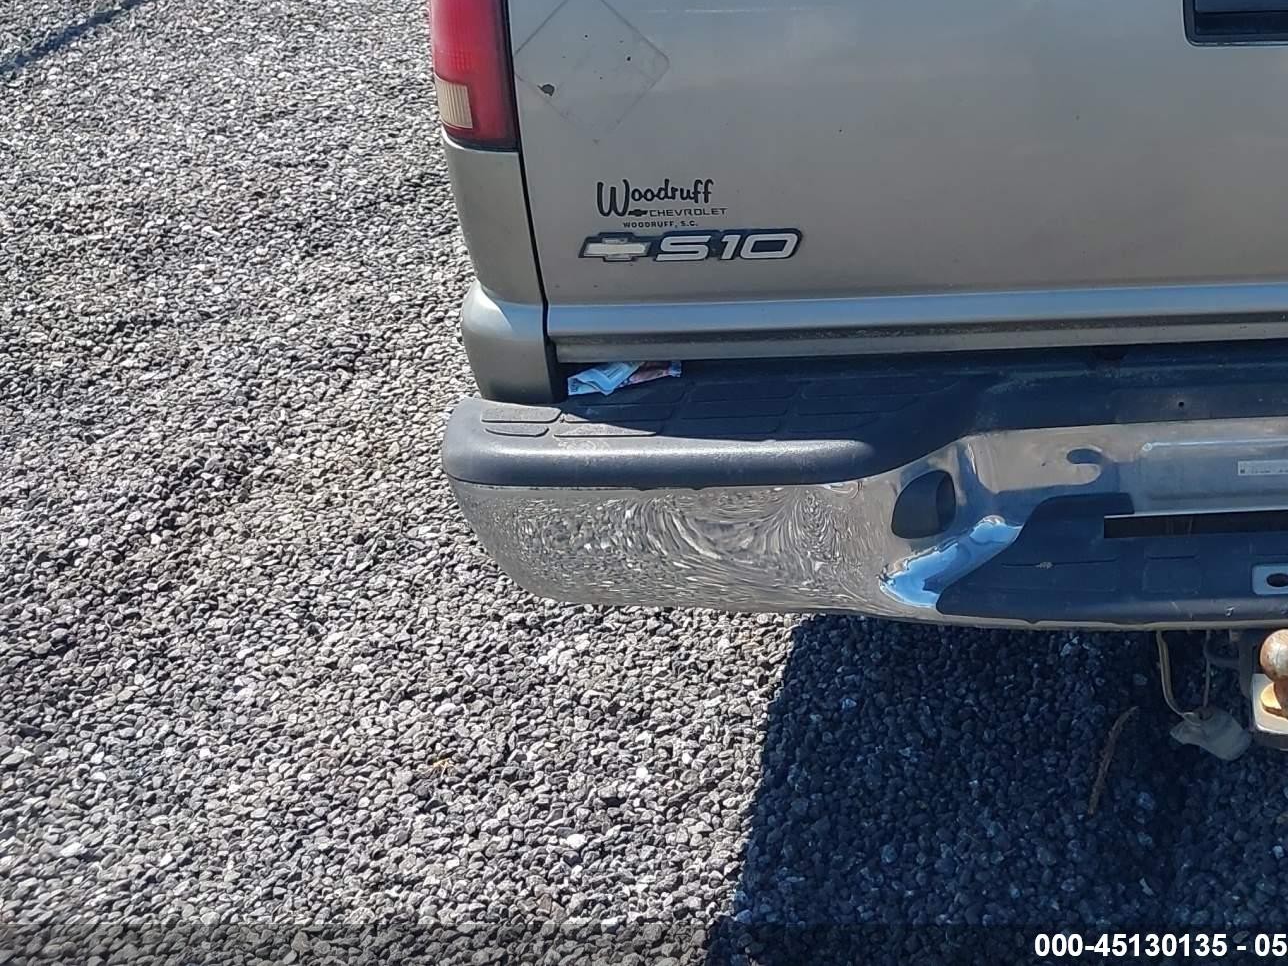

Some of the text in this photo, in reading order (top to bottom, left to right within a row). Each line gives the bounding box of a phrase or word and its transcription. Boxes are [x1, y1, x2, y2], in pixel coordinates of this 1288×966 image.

[597, 178, 714, 217] Woodruff
[649, 207, 728, 217] CHEVROLET
[653, 232, 801, 262] S10
